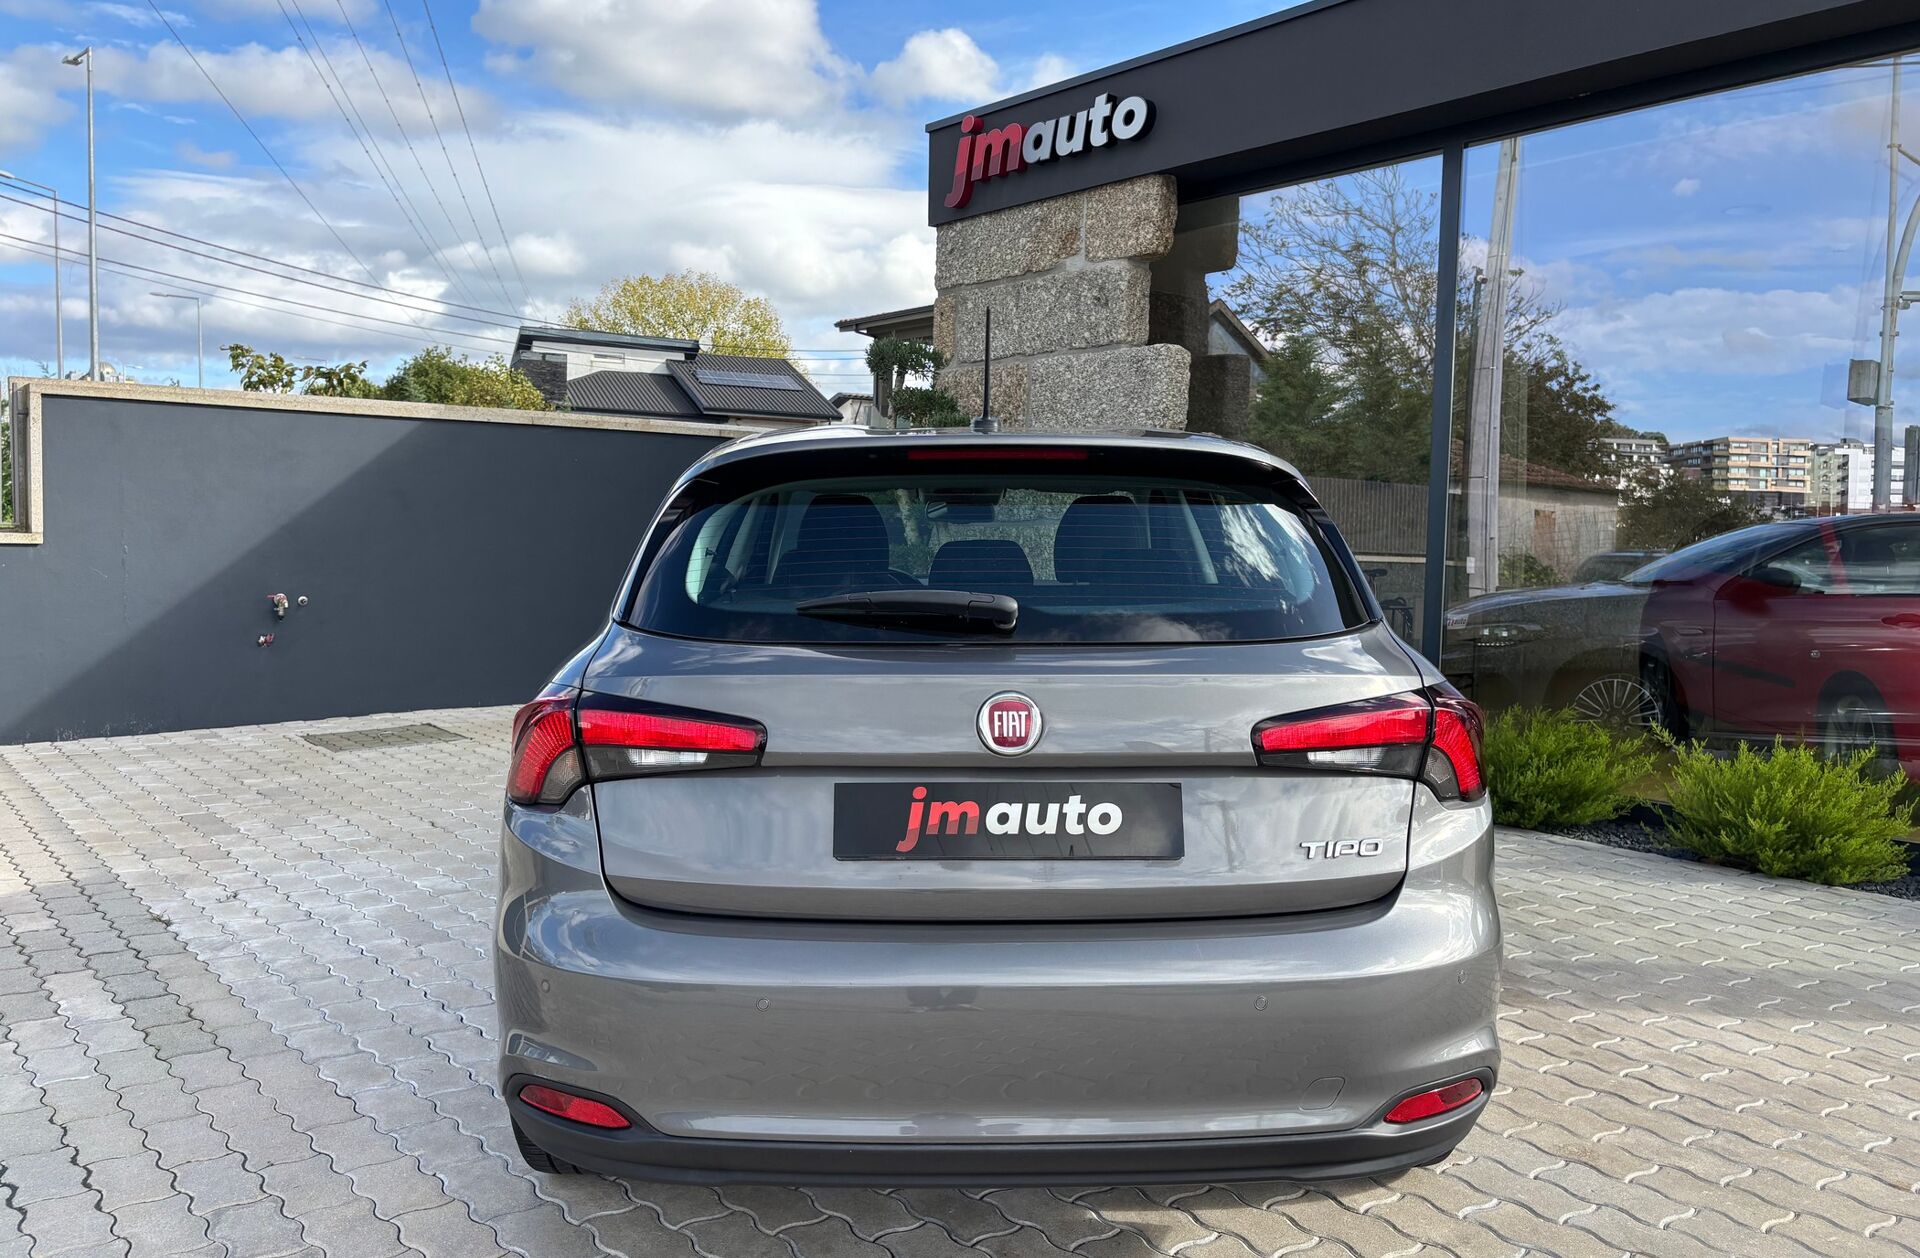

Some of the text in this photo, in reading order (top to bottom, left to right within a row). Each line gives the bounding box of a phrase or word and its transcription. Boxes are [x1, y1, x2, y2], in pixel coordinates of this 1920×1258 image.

[944, 92, 1149, 208] jmauto
[993, 711, 1028, 737] FIAT
[896, 787, 1123, 852] jmauto
[1299, 838, 1384, 859] TIPO
